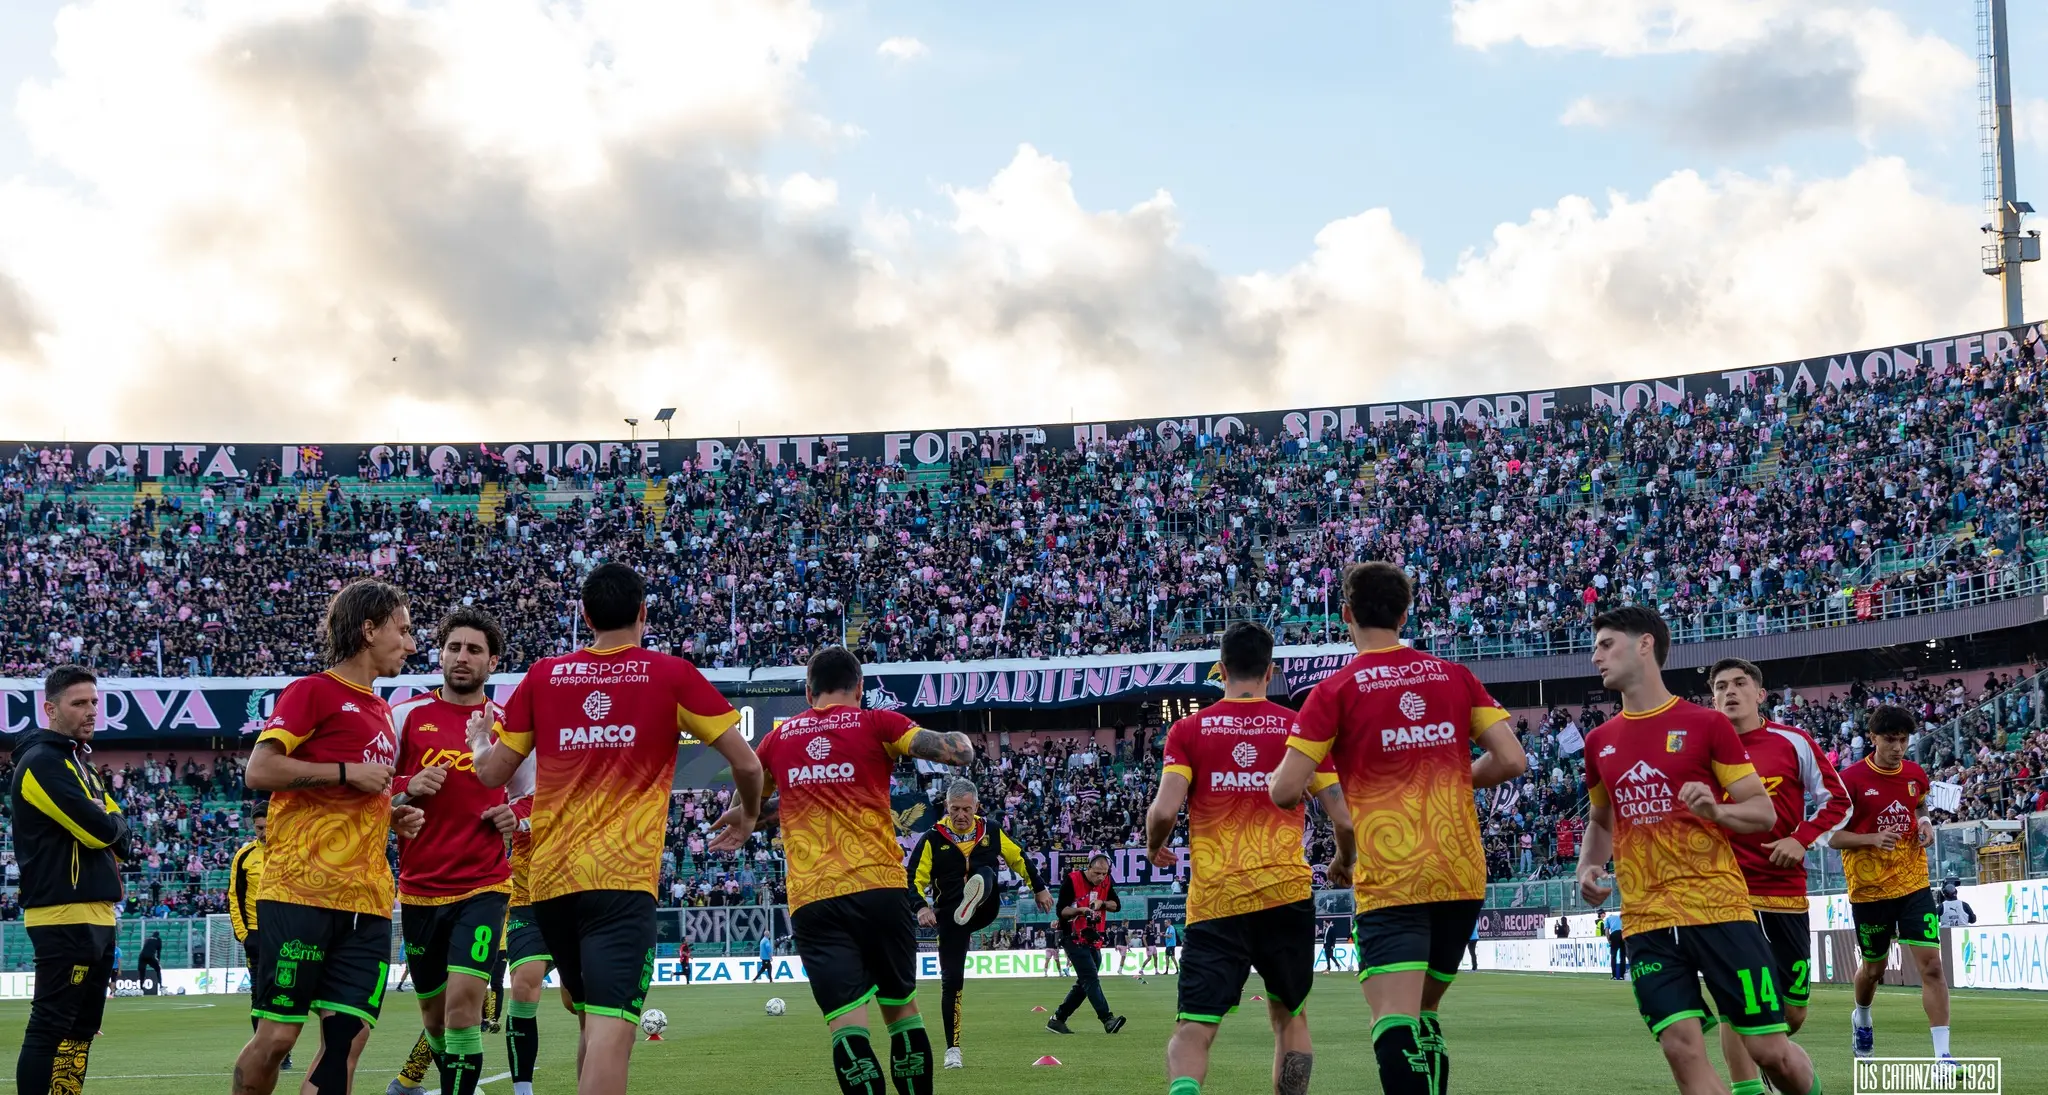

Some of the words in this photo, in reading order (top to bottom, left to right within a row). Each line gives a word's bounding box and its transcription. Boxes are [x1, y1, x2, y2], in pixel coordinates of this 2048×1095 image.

[370, 445, 461, 477] SUO
[503, 442, 659, 475] CUORE
[696, 435, 848, 472] BATTE
[1282, 392, 1555, 443] SPLENDORE
[1591, 377, 1684, 416] NON
[551, 661, 650, 675] EYESPORT
[1283, 657, 1311, 673] Per
[1313, 654, 1339, 669] chi
[1354, 660, 1442, 683] EYESPORT
[550, 673, 649, 686] eyesportwear.com
[912, 662, 1197, 707] APPARTENENZA
[1358, 673, 1449, 693] eyesportwear.com
[780, 720, 860, 740] eyesportwear.com
[1201, 715, 1286, 727] EYESPORT
[559, 725, 636, 746] PARCO
[1201, 727, 1287, 736] eyesportwear.com
[1381, 721, 1455, 747] PARCO
[1382, 743, 1410, 752] SALUTE
[788, 763, 855, 783] PARCO
[1615, 782, 1674, 804] SANTA
[1620, 799, 1673, 818] CROCE
[1877, 814, 1911, 825] SANTA
[678, 908, 769, 943] BORGO
[1504, 914, 1548, 931] RECUPER
[1924, 913, 1939, 939] 3
[471, 925, 492, 962] 8
[654, 961, 732, 982] ENZA
[1789, 958, 1810, 995] 2
[1737, 966, 1780, 1015] 14
